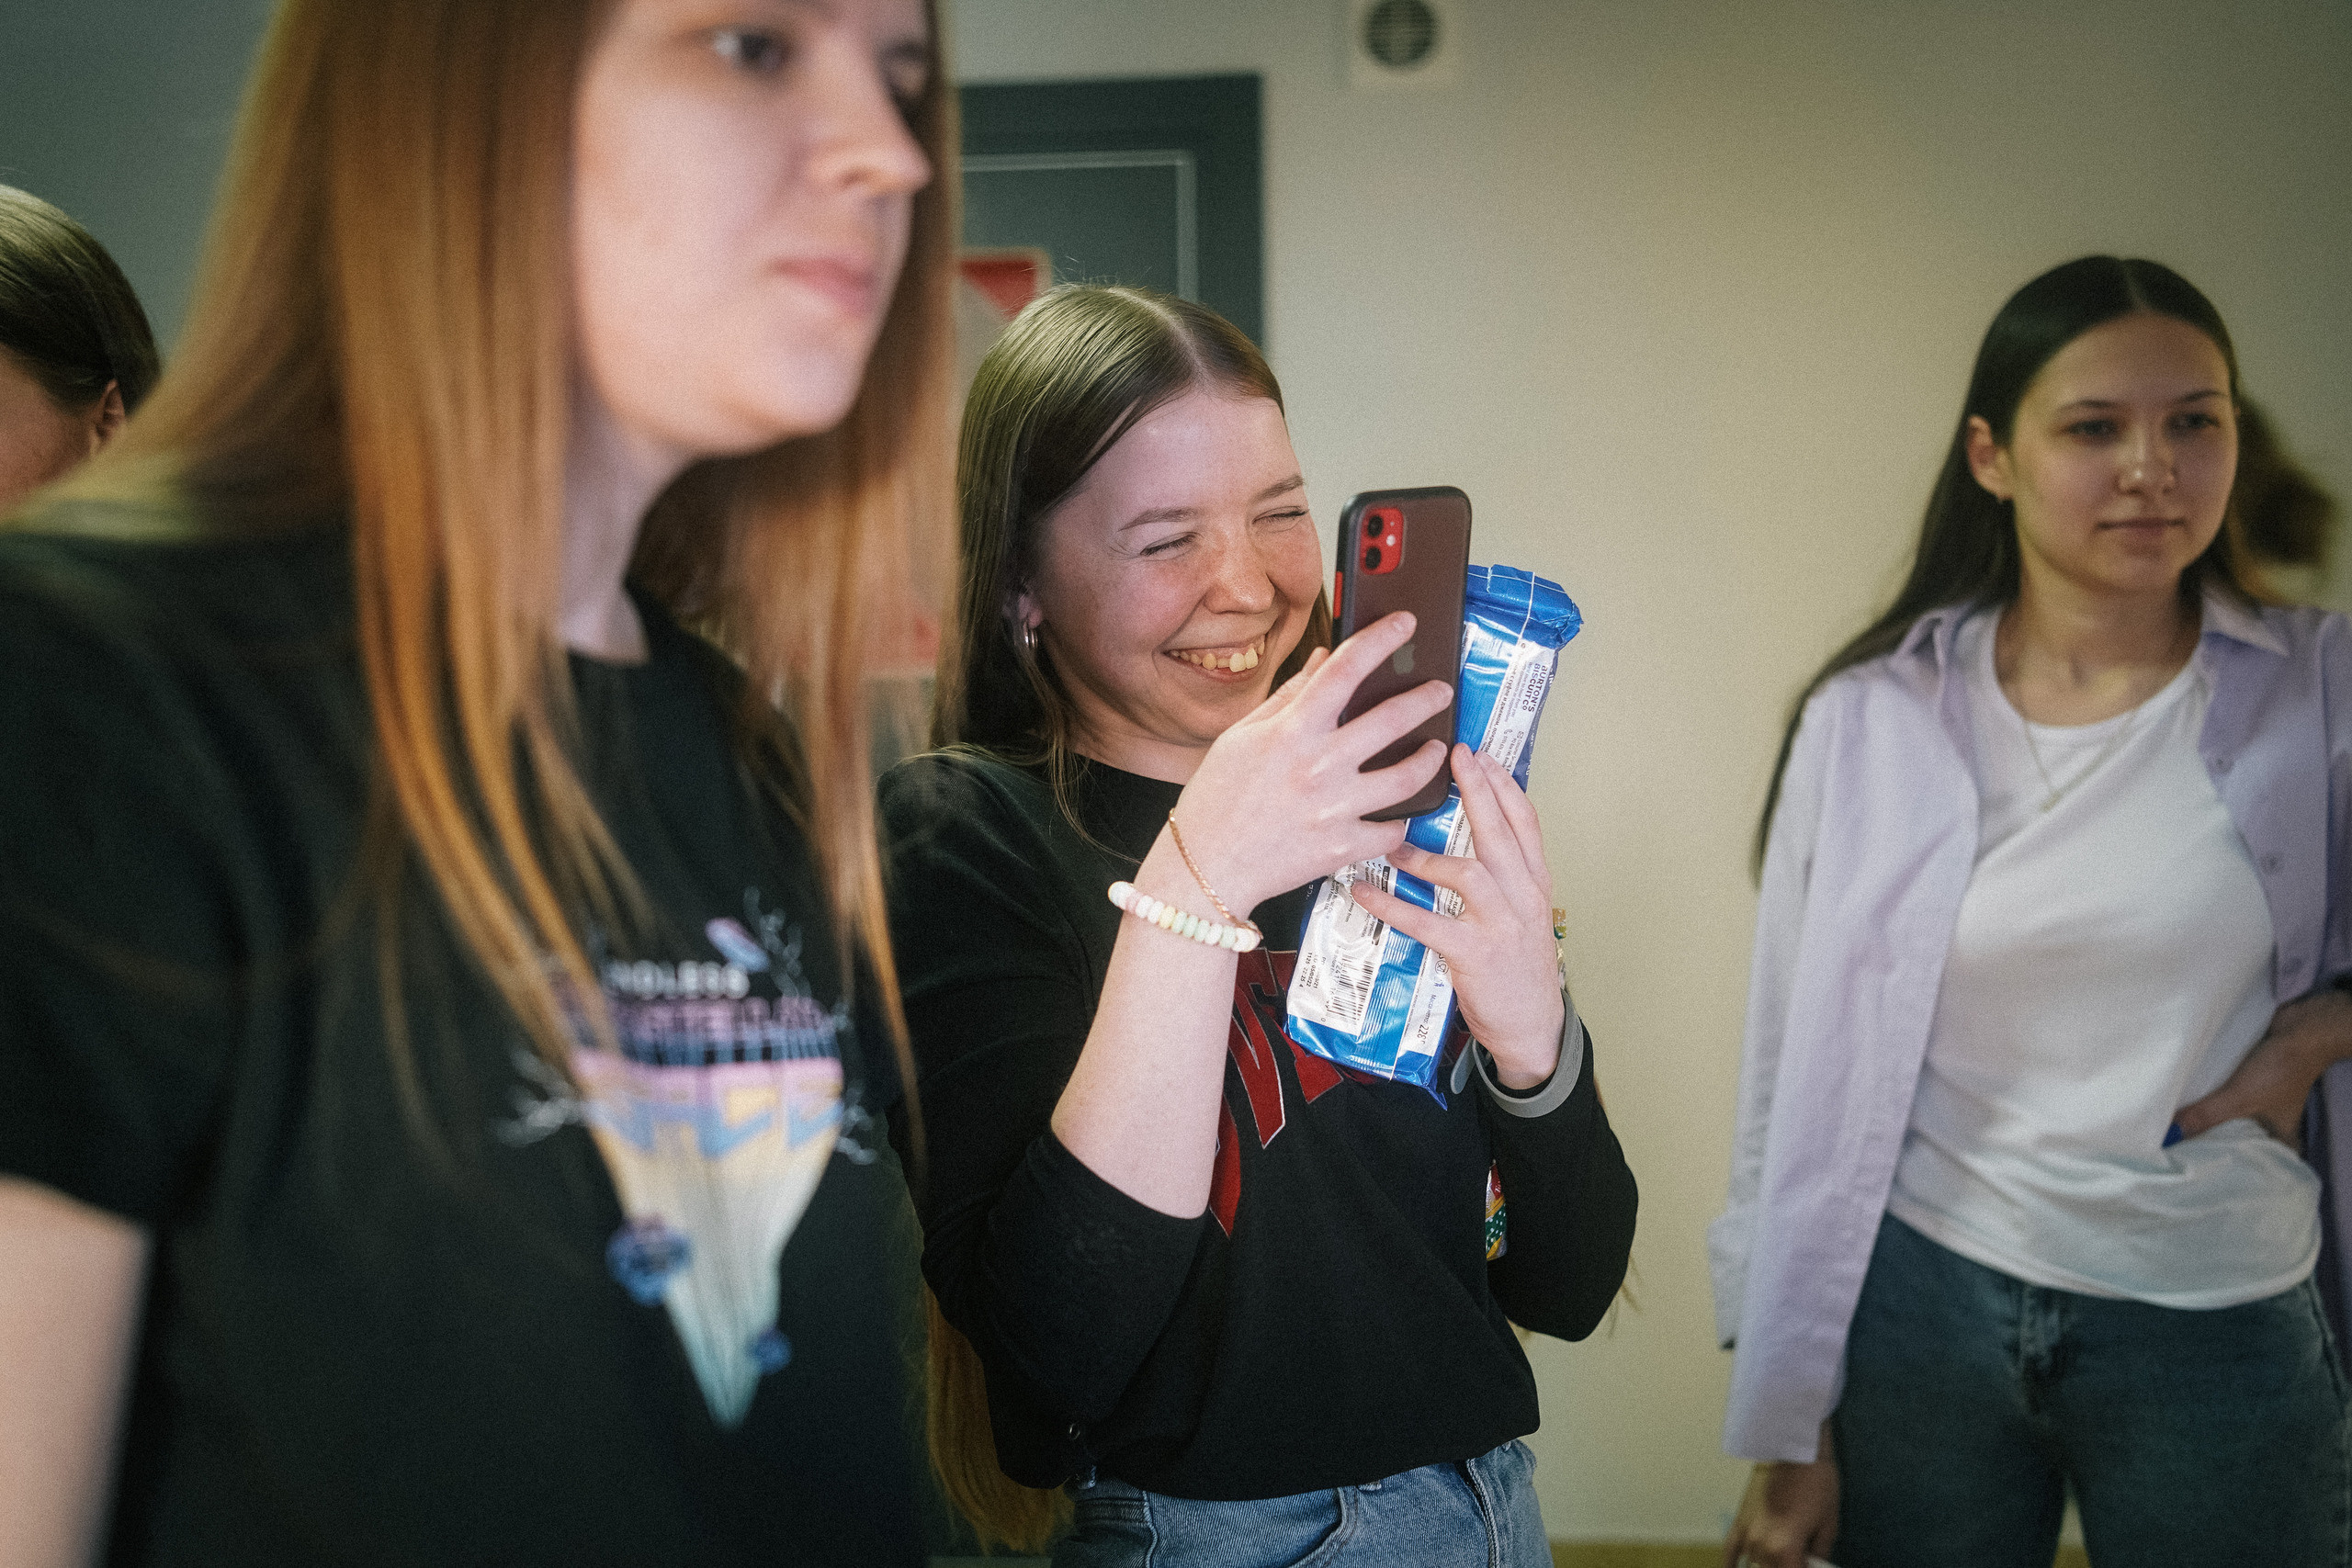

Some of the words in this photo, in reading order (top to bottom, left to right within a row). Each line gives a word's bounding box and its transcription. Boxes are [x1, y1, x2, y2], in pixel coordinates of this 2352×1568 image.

[1524, 662, 1541, 699] BISCUIT
[1527, 665, 1548, 713] BURTON'S
[1306, 964, 1316, 987] 05/05/22
